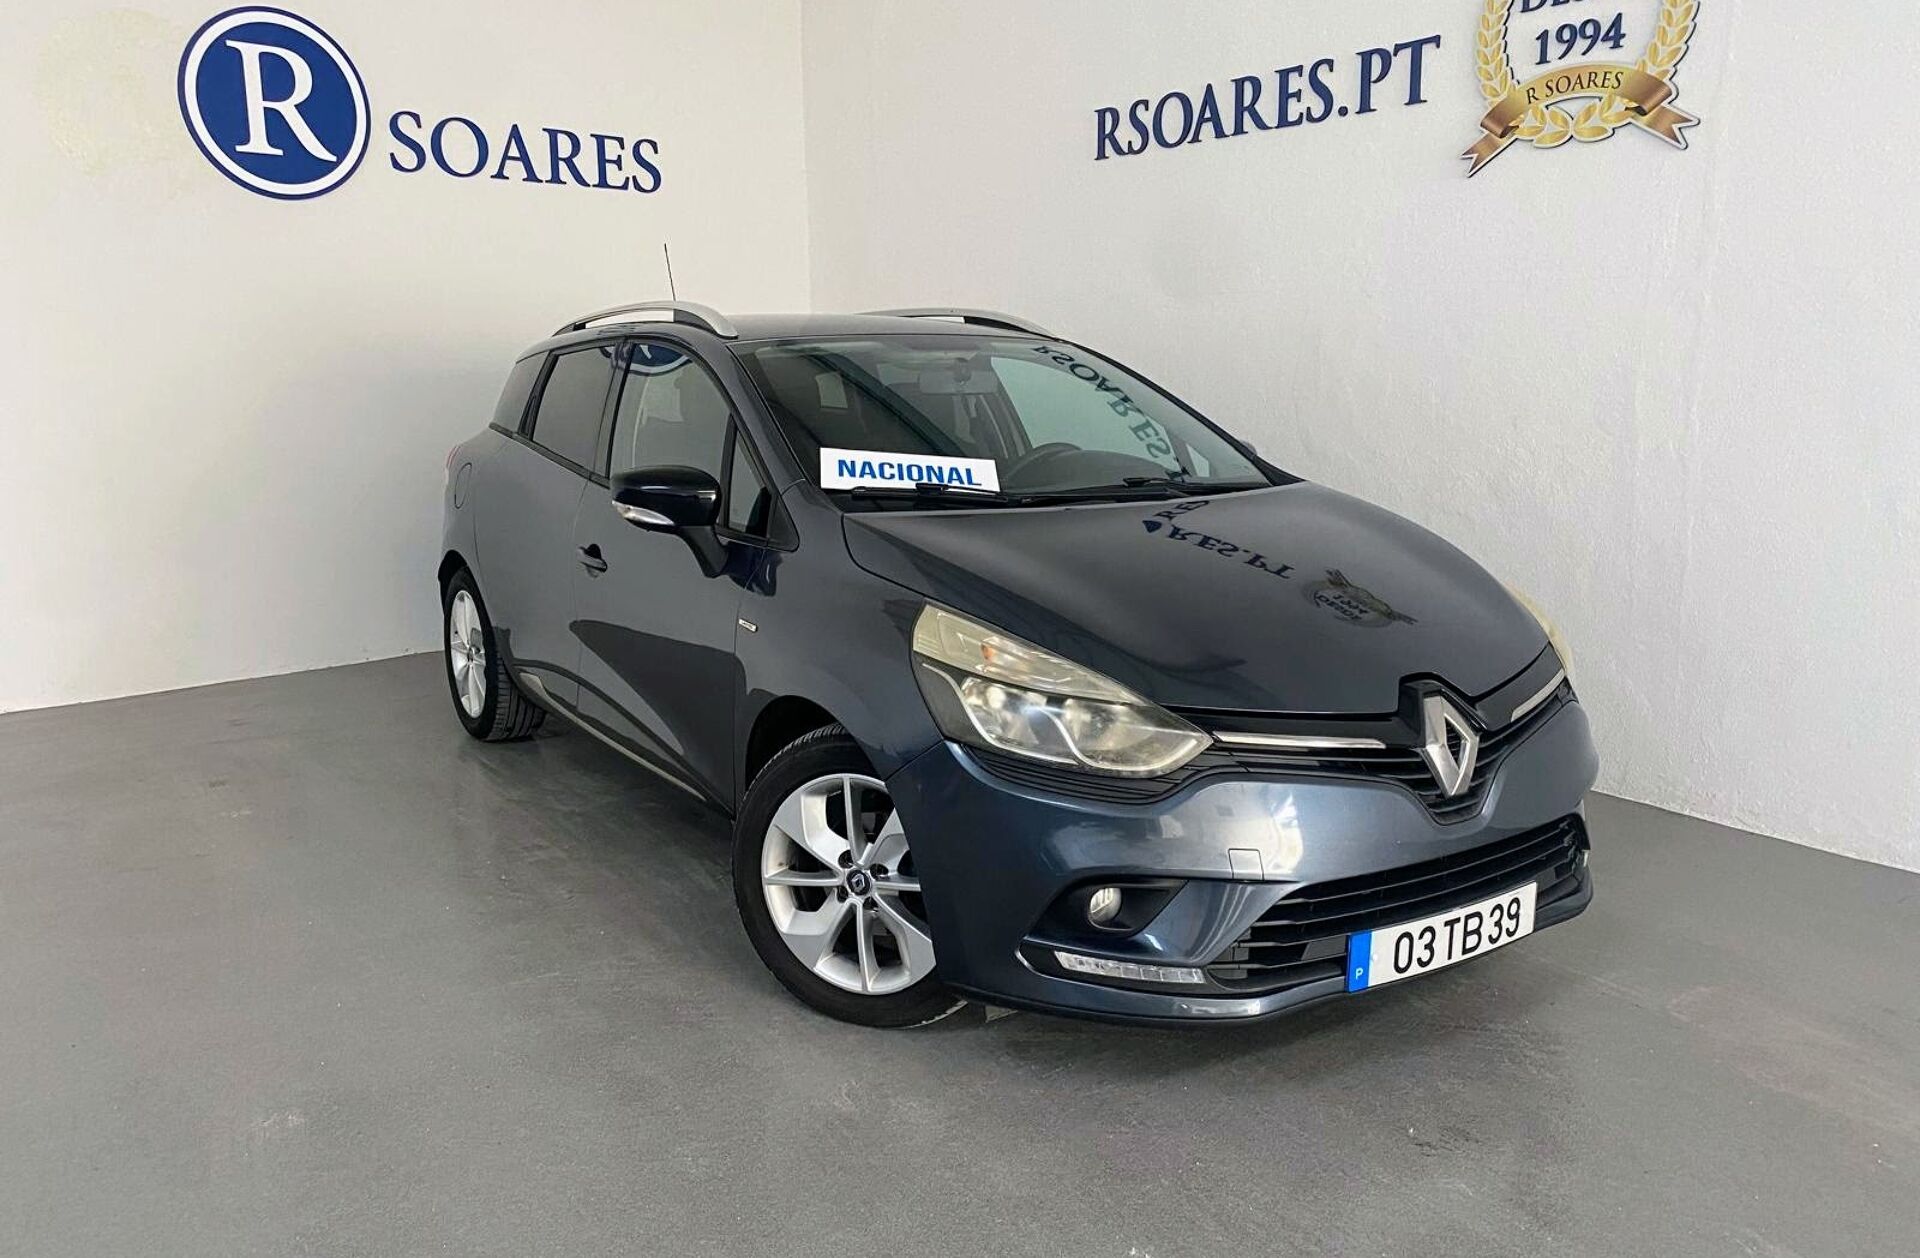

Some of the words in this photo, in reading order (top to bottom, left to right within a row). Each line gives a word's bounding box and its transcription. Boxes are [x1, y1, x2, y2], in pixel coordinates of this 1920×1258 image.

[1535, 12, 1627, 66] 1994
[1094, 34, 1441, 161] RSOARES.PT
[1526, 87, 1540, 105] R
[1544, 70, 1624, 99] SOARES
[226, 39, 337, 162] R
[388, 110, 662, 194] SOARES
[837, 459, 983, 487] NACIONAL
[1355, 967, 1364, 980] P
